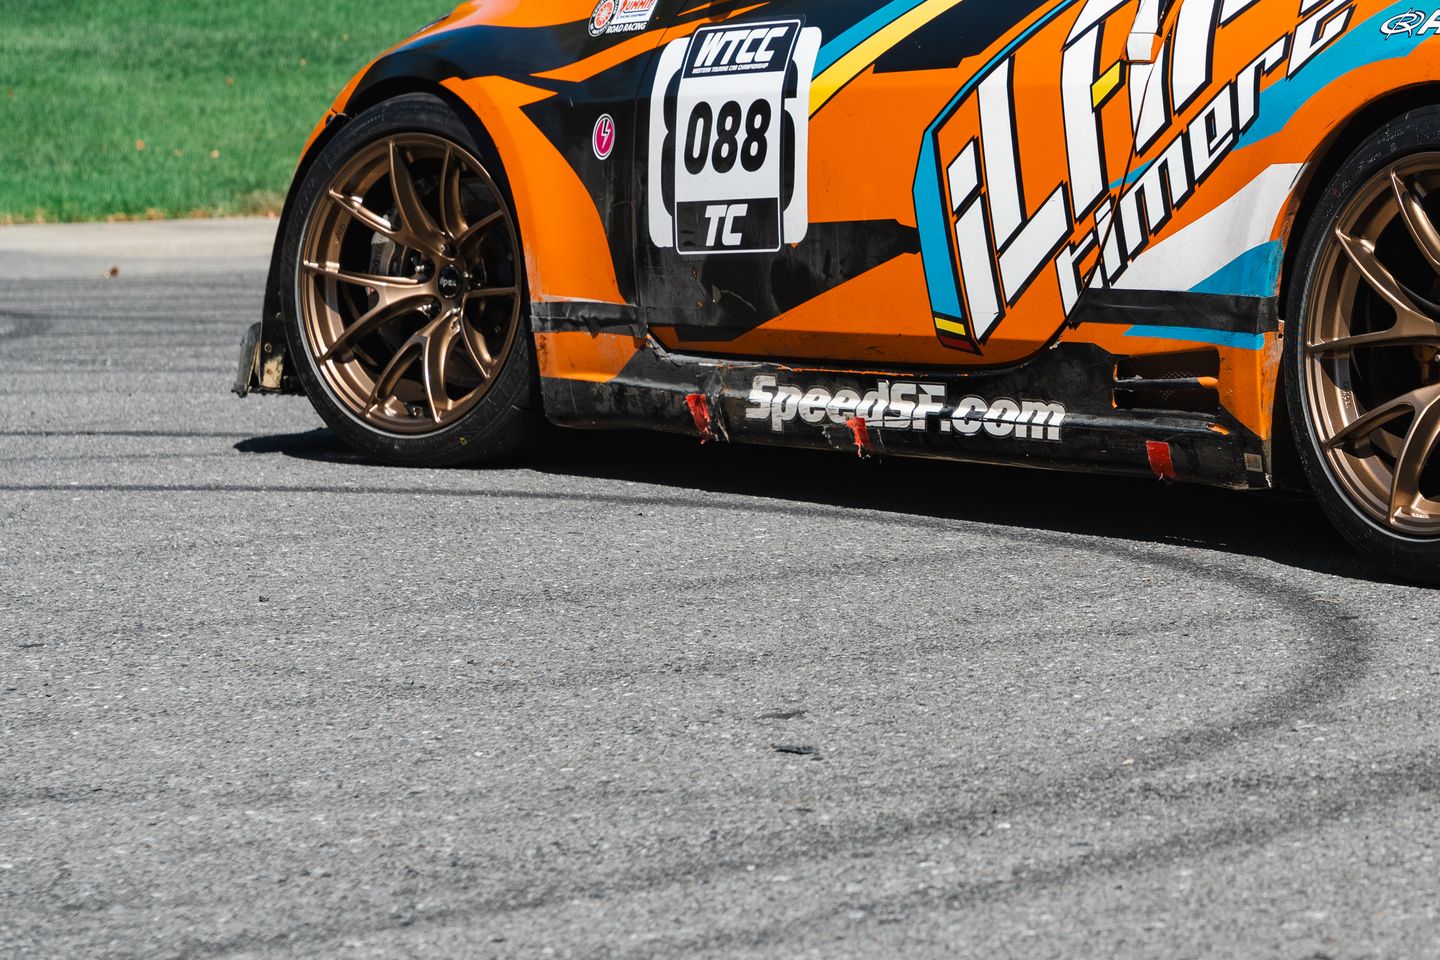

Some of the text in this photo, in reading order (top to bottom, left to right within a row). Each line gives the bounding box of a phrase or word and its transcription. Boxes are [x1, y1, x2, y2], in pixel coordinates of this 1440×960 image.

[606, 21, 648, 34] ROAD RACING
[694, 26, 789, 68] WTCC
[683, 98, 772, 175] 088
[704, 203, 749, 247] TC
[745, 375, 1066, 441] SpeedSF.com
